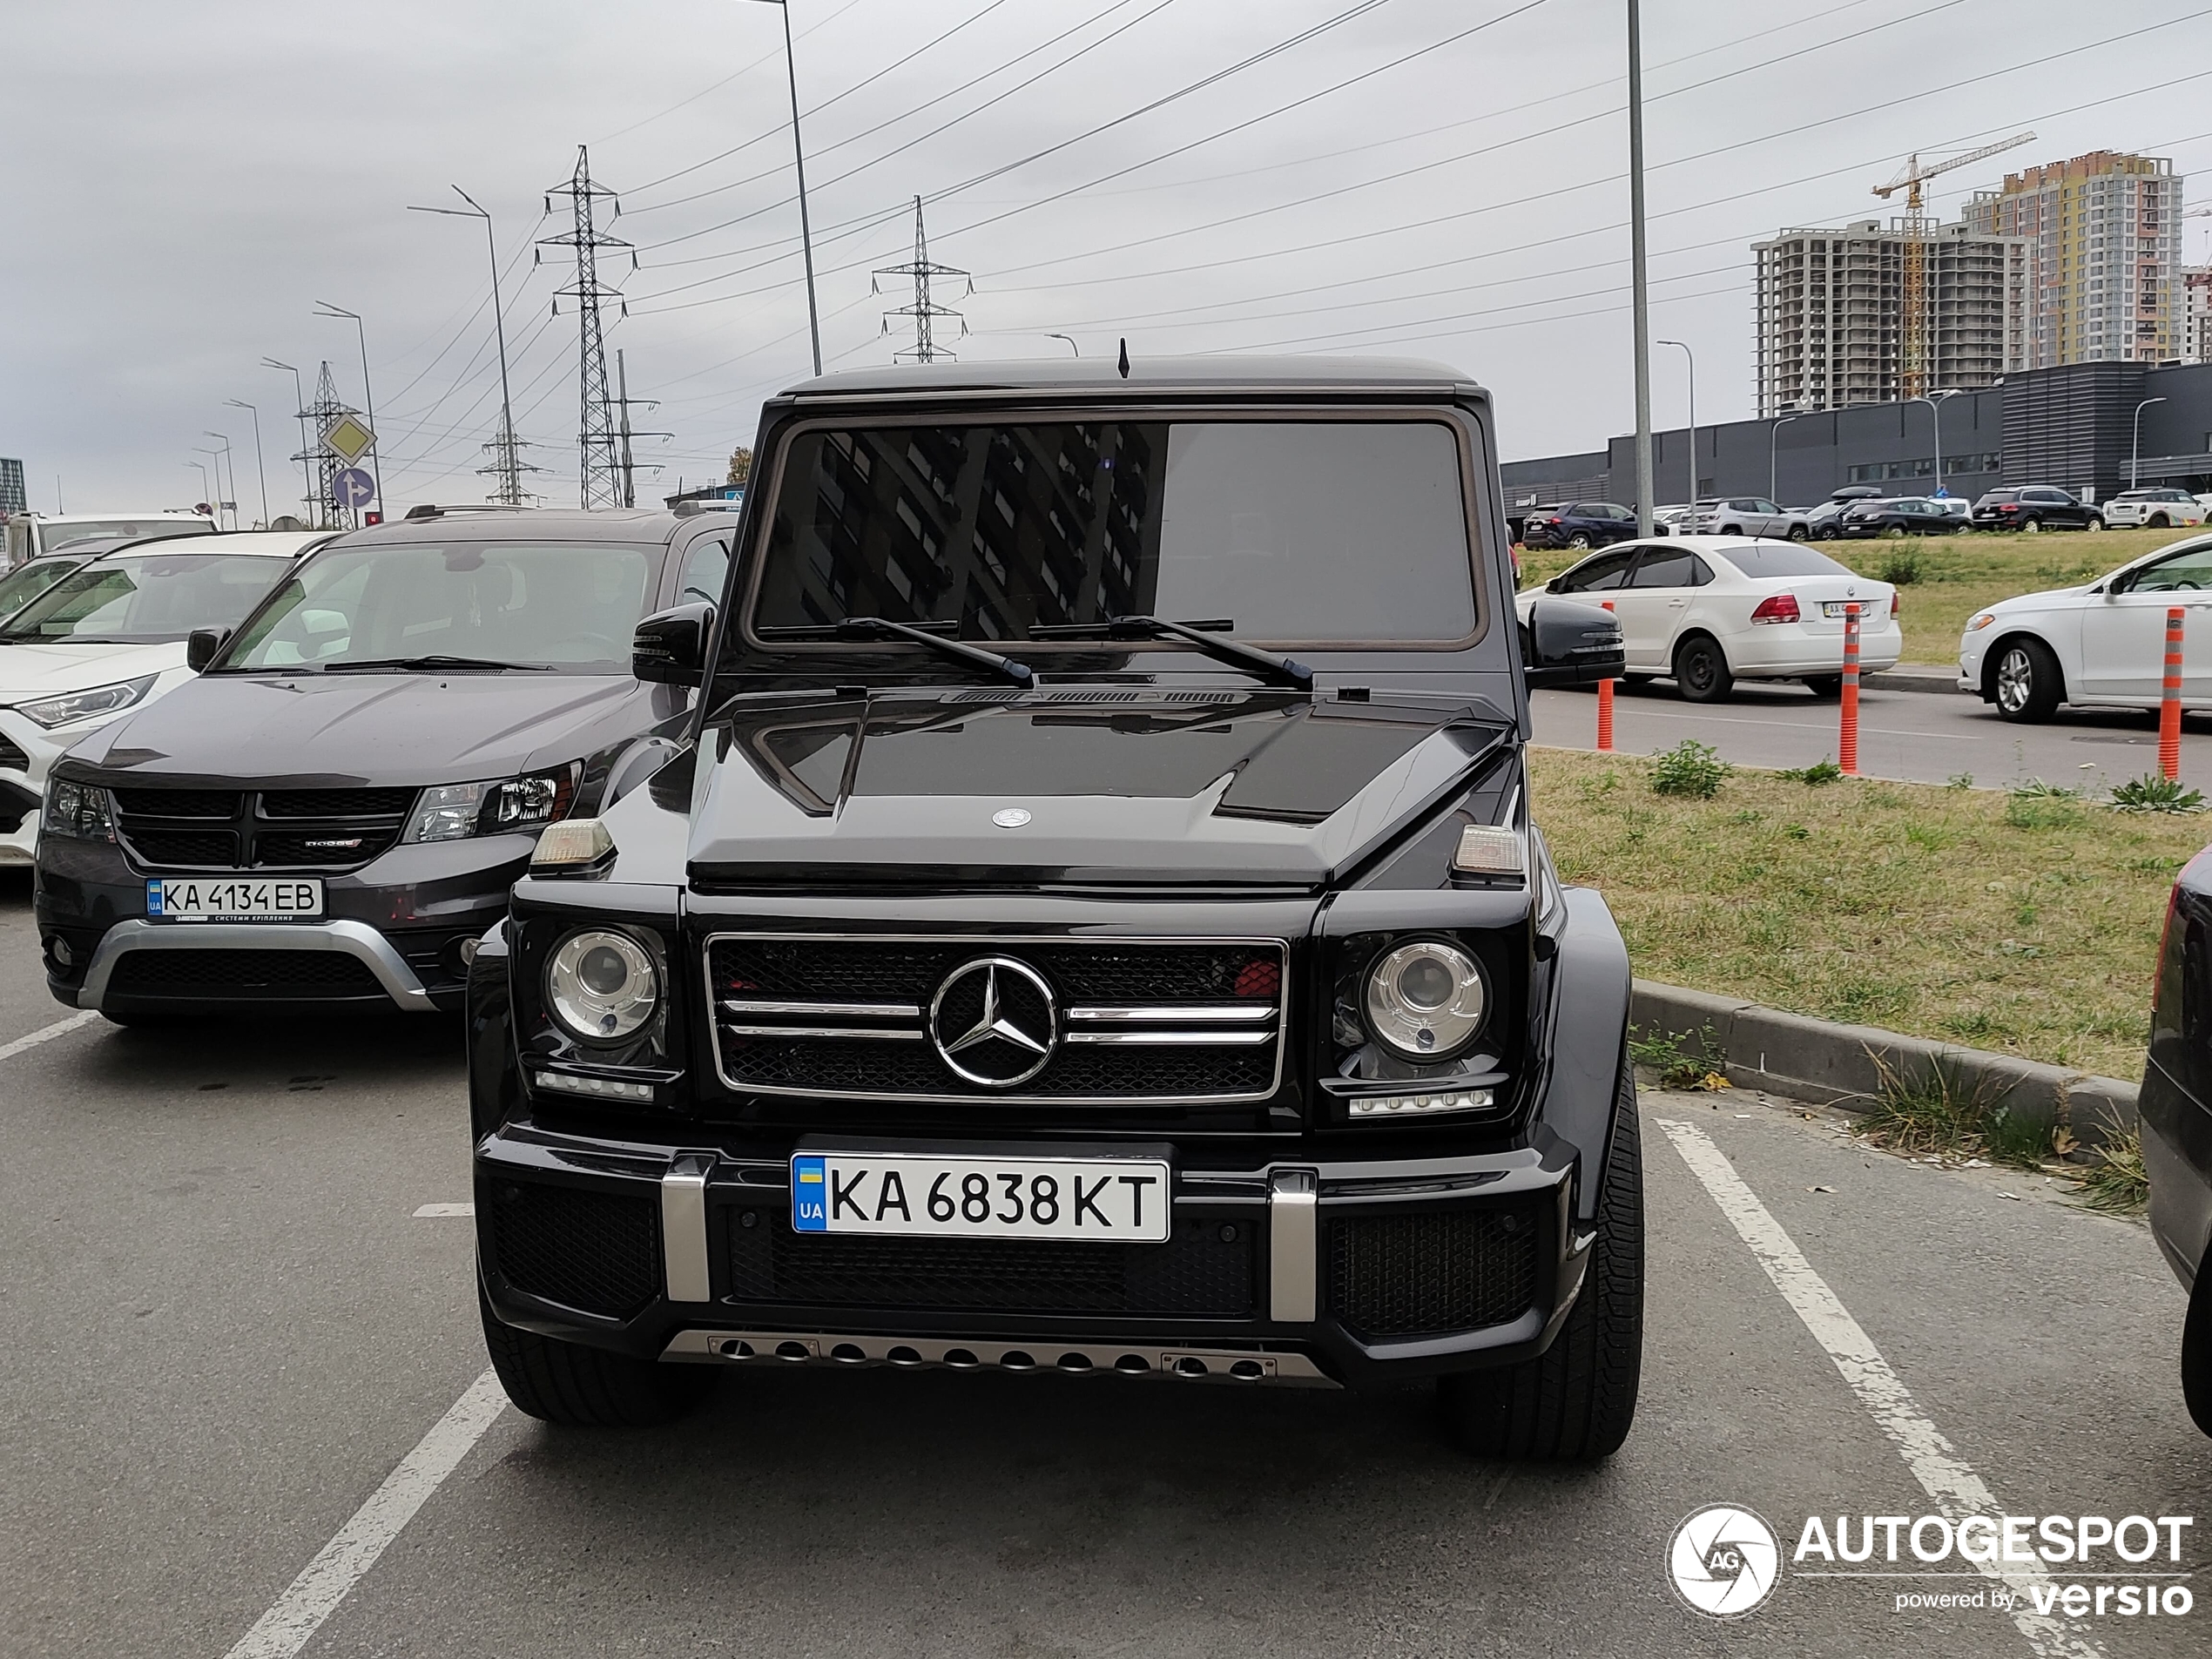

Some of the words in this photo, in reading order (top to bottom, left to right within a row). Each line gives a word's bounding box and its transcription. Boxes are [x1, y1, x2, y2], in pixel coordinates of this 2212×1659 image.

[164, 884, 200, 911] KA
[208, 884, 268, 911] 4134
[275, 883, 314, 910] EB
[800, 1203, 823, 1219] UA
[832, 1170, 912, 1222] KA
[927, 1172, 1060, 1225] 6838
[1074, 1175, 1157, 1227] KT
